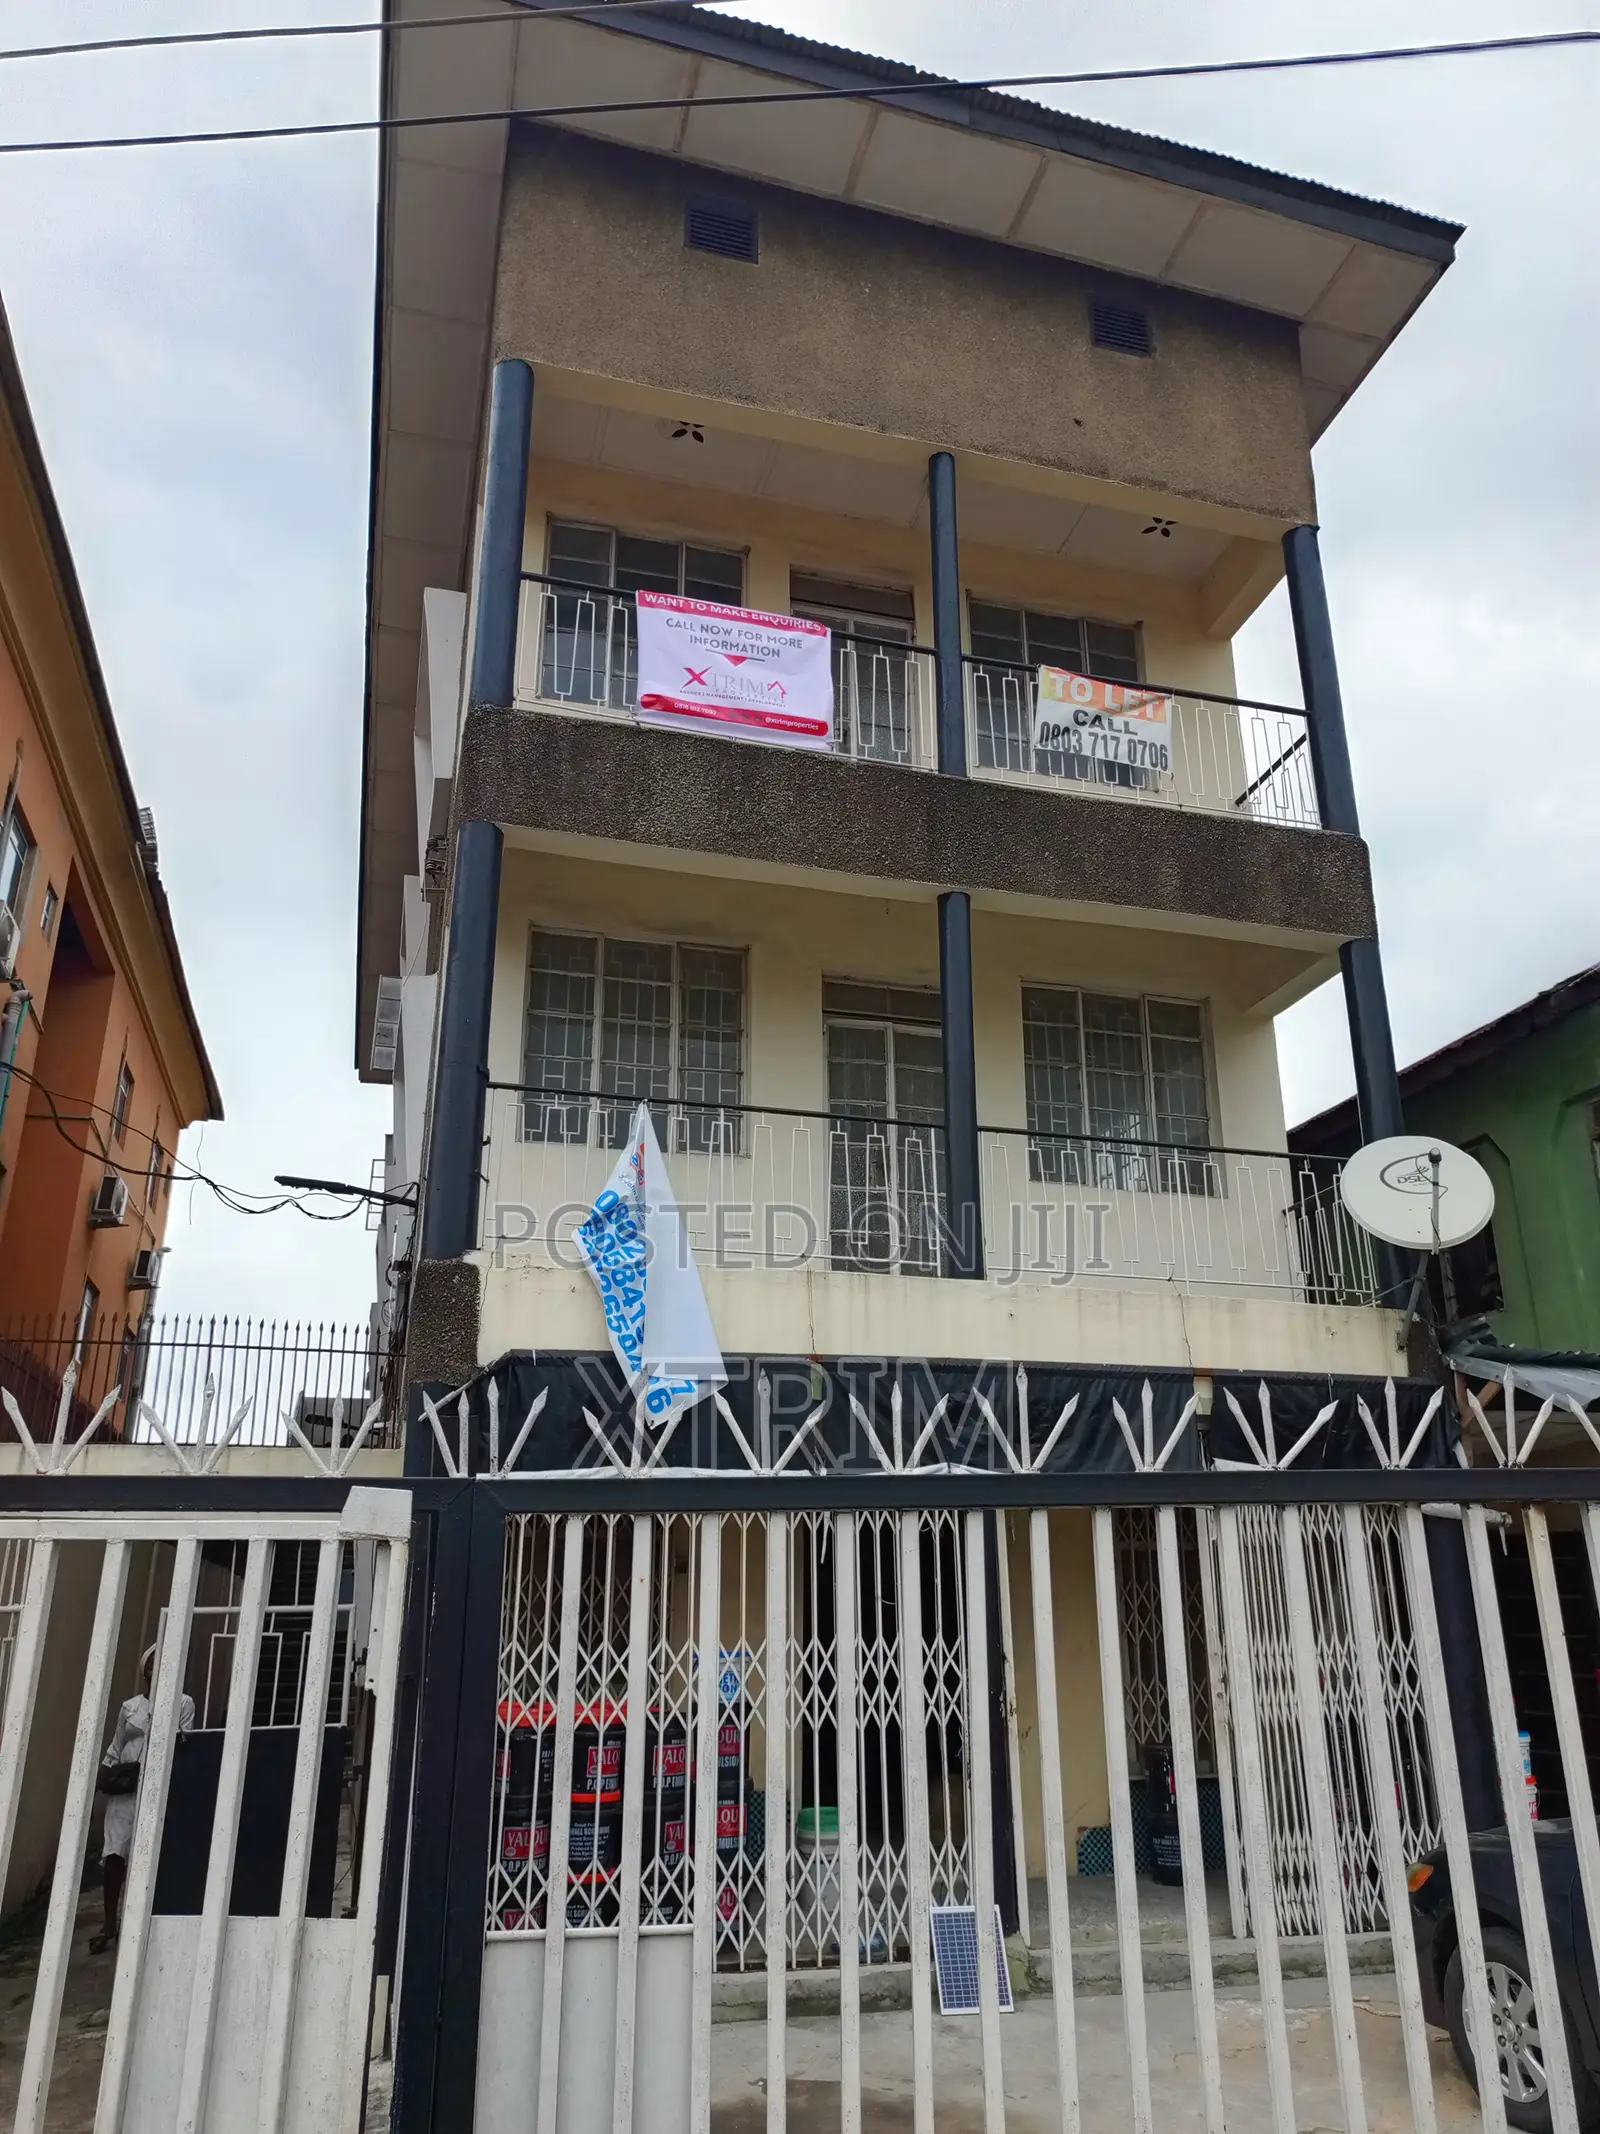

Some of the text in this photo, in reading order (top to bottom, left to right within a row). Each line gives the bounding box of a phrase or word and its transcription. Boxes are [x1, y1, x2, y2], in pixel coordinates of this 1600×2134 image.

[644, 593, 822, 632] WANT TO MAKE ENQUIRIES
[665, 617, 803, 649] CALL NOW FOR MORE
[689, 635, 781, 659] INFORMATION
[681, 666, 764, 696] XTRIM
[1049, 672, 1163, 719] TO LET
[706, 692, 744, 701] MANAGEMENT
[765, 716, 819, 731] @xtrimproperties
[1072, 709, 1139, 736] CALL
[1039, 721, 1169, 772] 0803 717 0706
